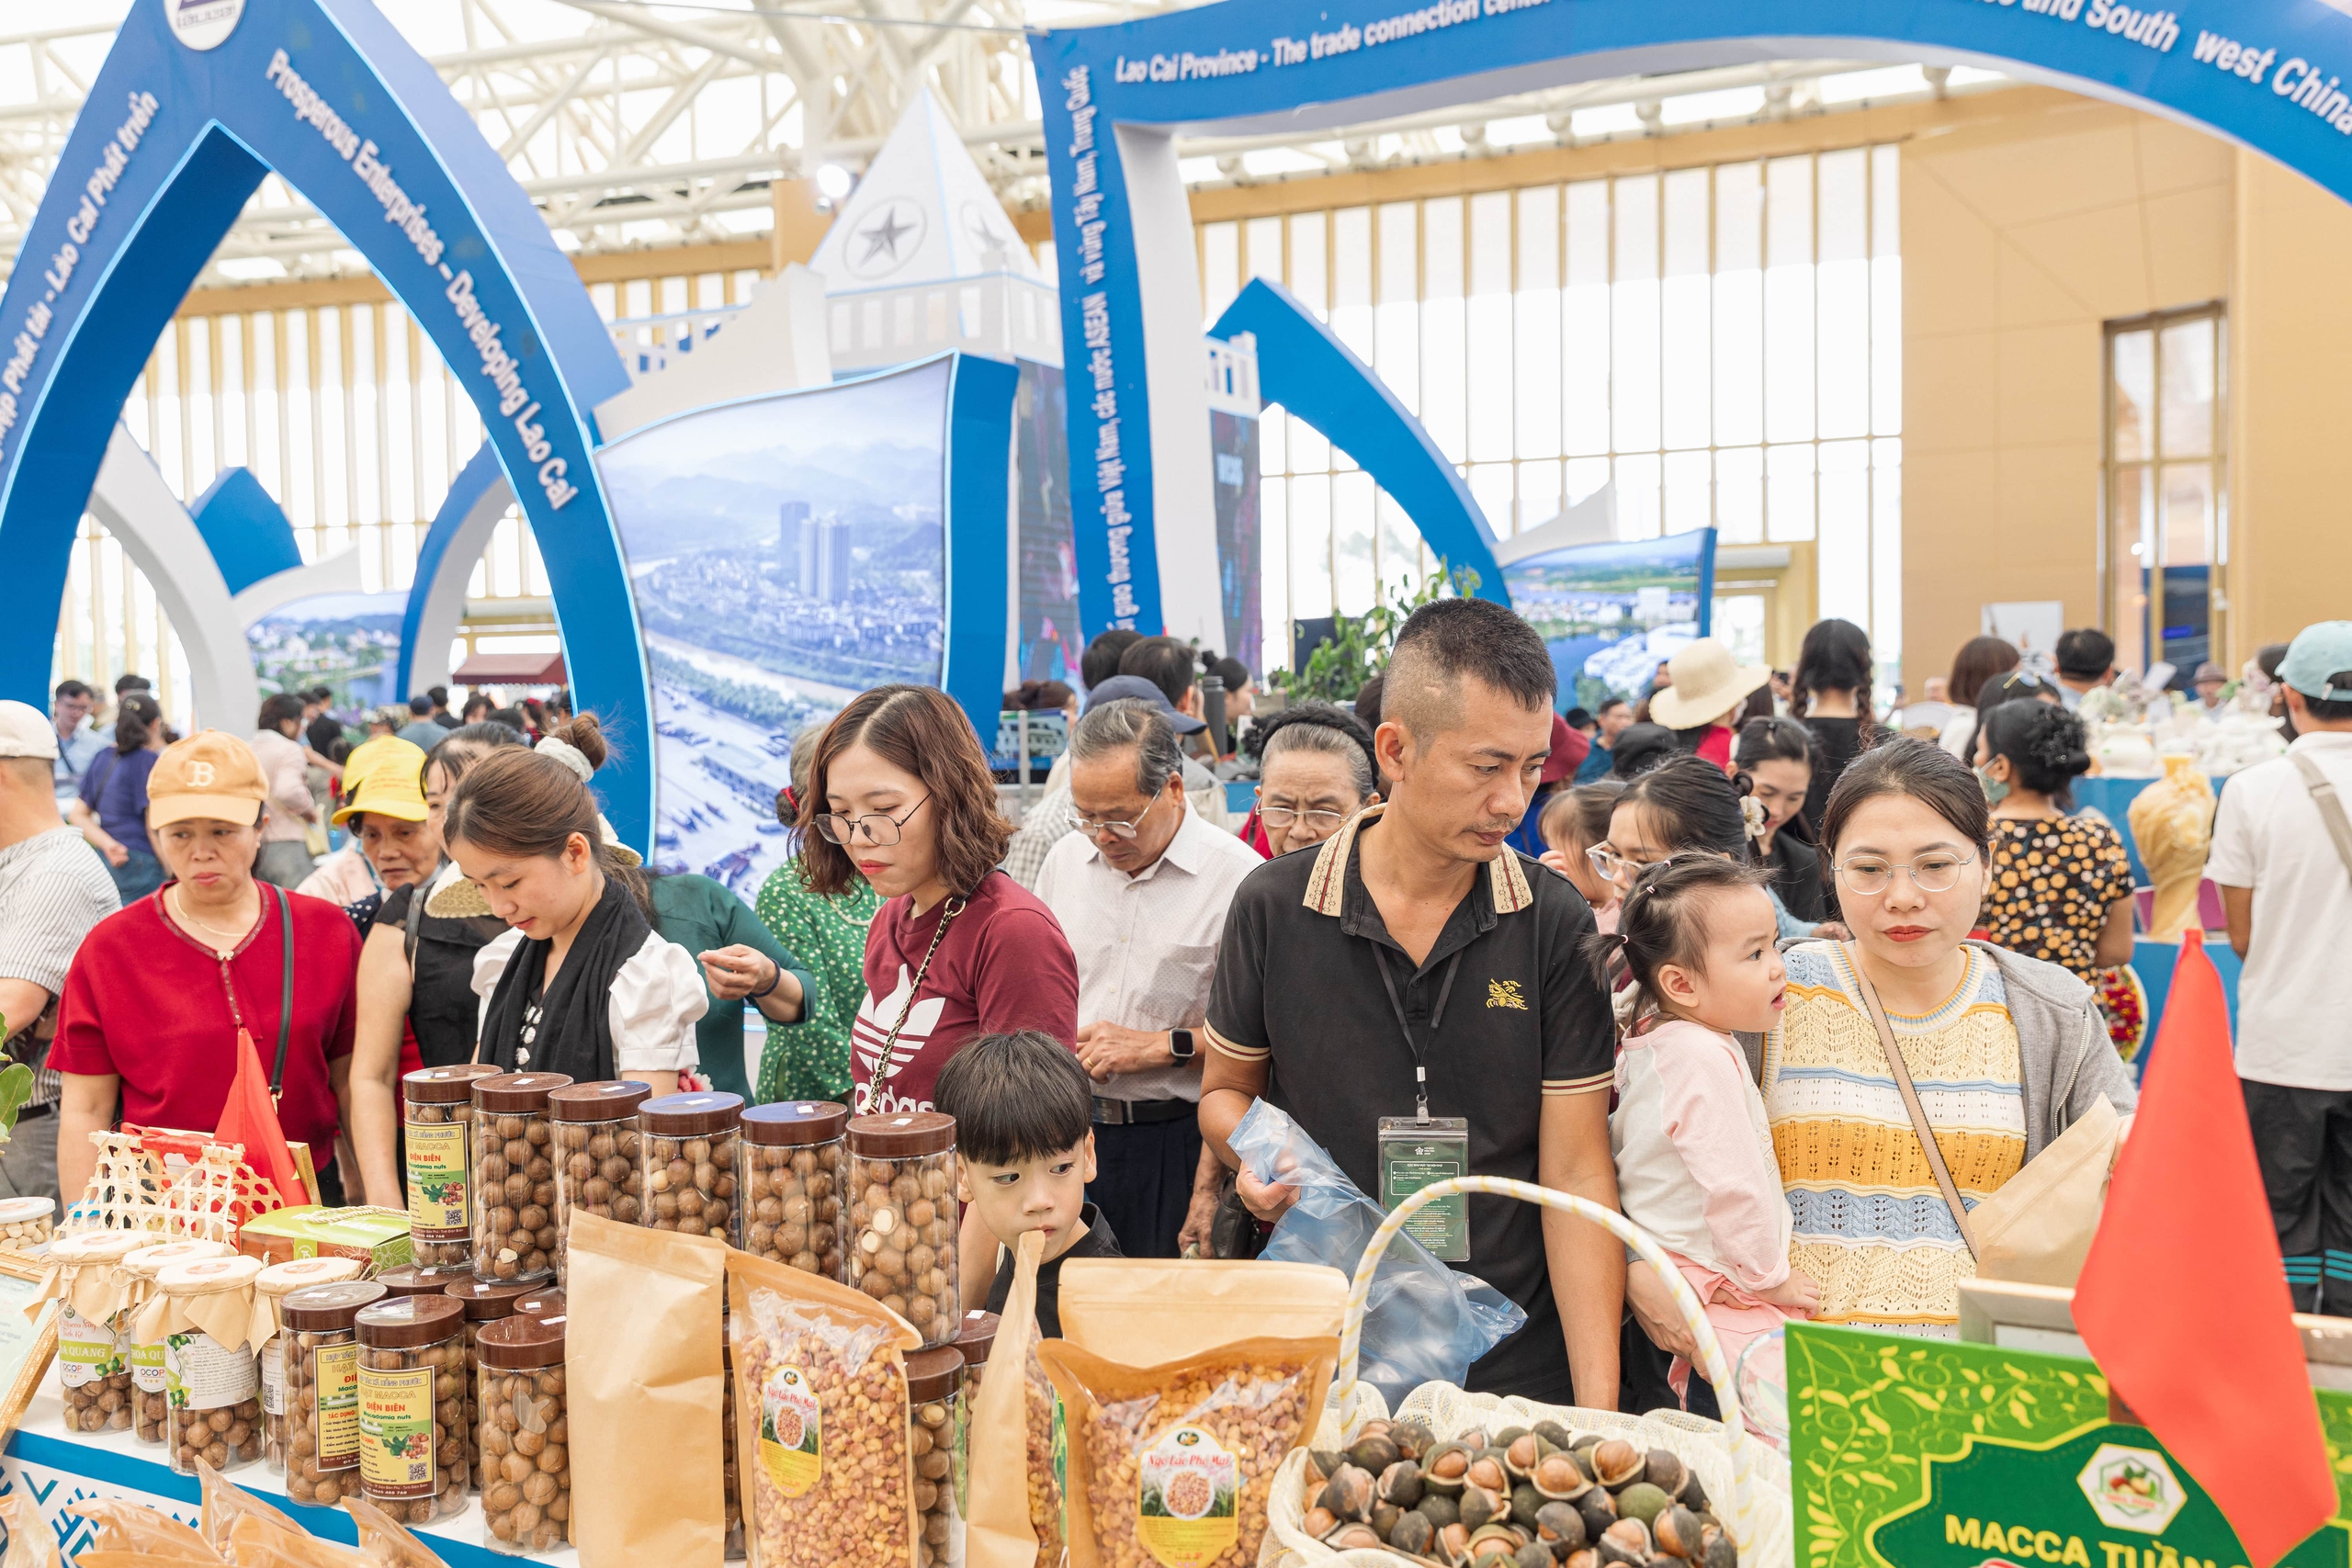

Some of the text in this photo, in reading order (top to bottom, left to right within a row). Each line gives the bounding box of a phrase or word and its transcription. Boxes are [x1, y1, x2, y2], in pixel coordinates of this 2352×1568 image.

[1114, 55, 1148, 84] Lao
[1149, 52, 1180, 83] Cai
[1180, 47, 1259, 81] Province
[1271, 36, 1308, 67] The
[1309, 21, 1363, 60] trade
[1363, 0, 1480, 47] connection
[2085, 0, 2181, 53] South
[2192, 29, 2278, 85] west
[2271, 57, 2352, 136] China
[1069, 105, 1098, 158] Trung
[67, 194, 100, 245] Cai
[265, 47, 361, 162] Prosperous
[352, 139, 446, 265] Enterprises
[446, 269, 530, 418] Developing
[514, 401, 551, 463] Lao
[538, 457, 579, 511] Cai
[1080, 260, 1105, 286] và
[1081, 291, 1111, 349] ASEAN
[1091, 389, 1117, 420] các
[1112, 583, 1140, 618] giao
[424, 1153, 441, 1162] BIÊN
[69, 1346, 106, 1358] QUANG
[62, 1363, 83, 1372] OCOP
[141, 1368, 165, 1377] OCOP
[332, 1362, 355, 1373] HẠT
[344, 1371, 358, 1383] ĐIỆ
[366, 1401, 382, 1413] ĐIỆN
[385, 1403, 406, 1412] BIÊN
[374, 1390, 416, 1400] MACCA
[1945, 1513, 2092, 1568] MACCA
